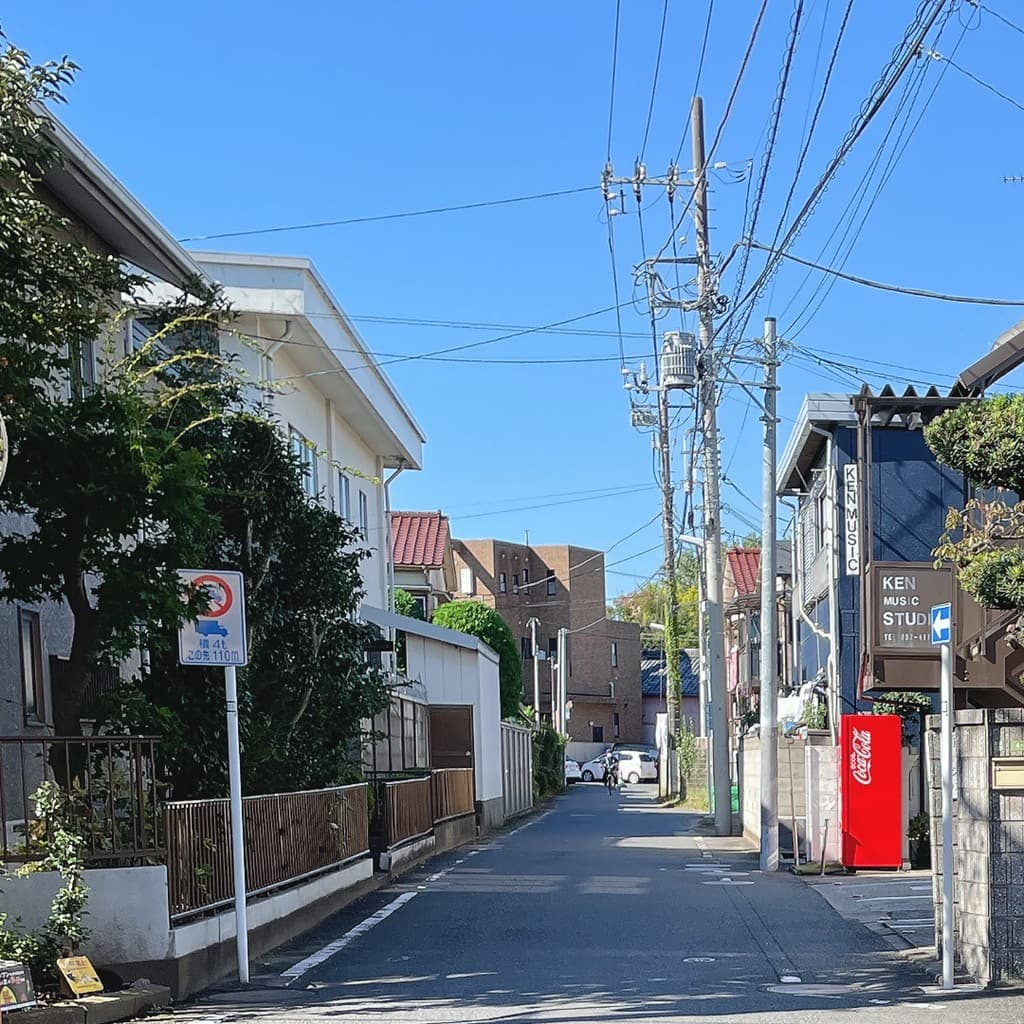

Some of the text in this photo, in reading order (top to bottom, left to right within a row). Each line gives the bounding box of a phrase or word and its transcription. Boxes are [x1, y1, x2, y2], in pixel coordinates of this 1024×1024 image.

[846, 468, 858, 571] KEN MUSIC
[883, 576, 915, 590] KEN
[883, 596, 920, 606] MUSIC
[883, 611, 931, 626] STUDI
[852, 726, 872, 785] Coca-Cola
